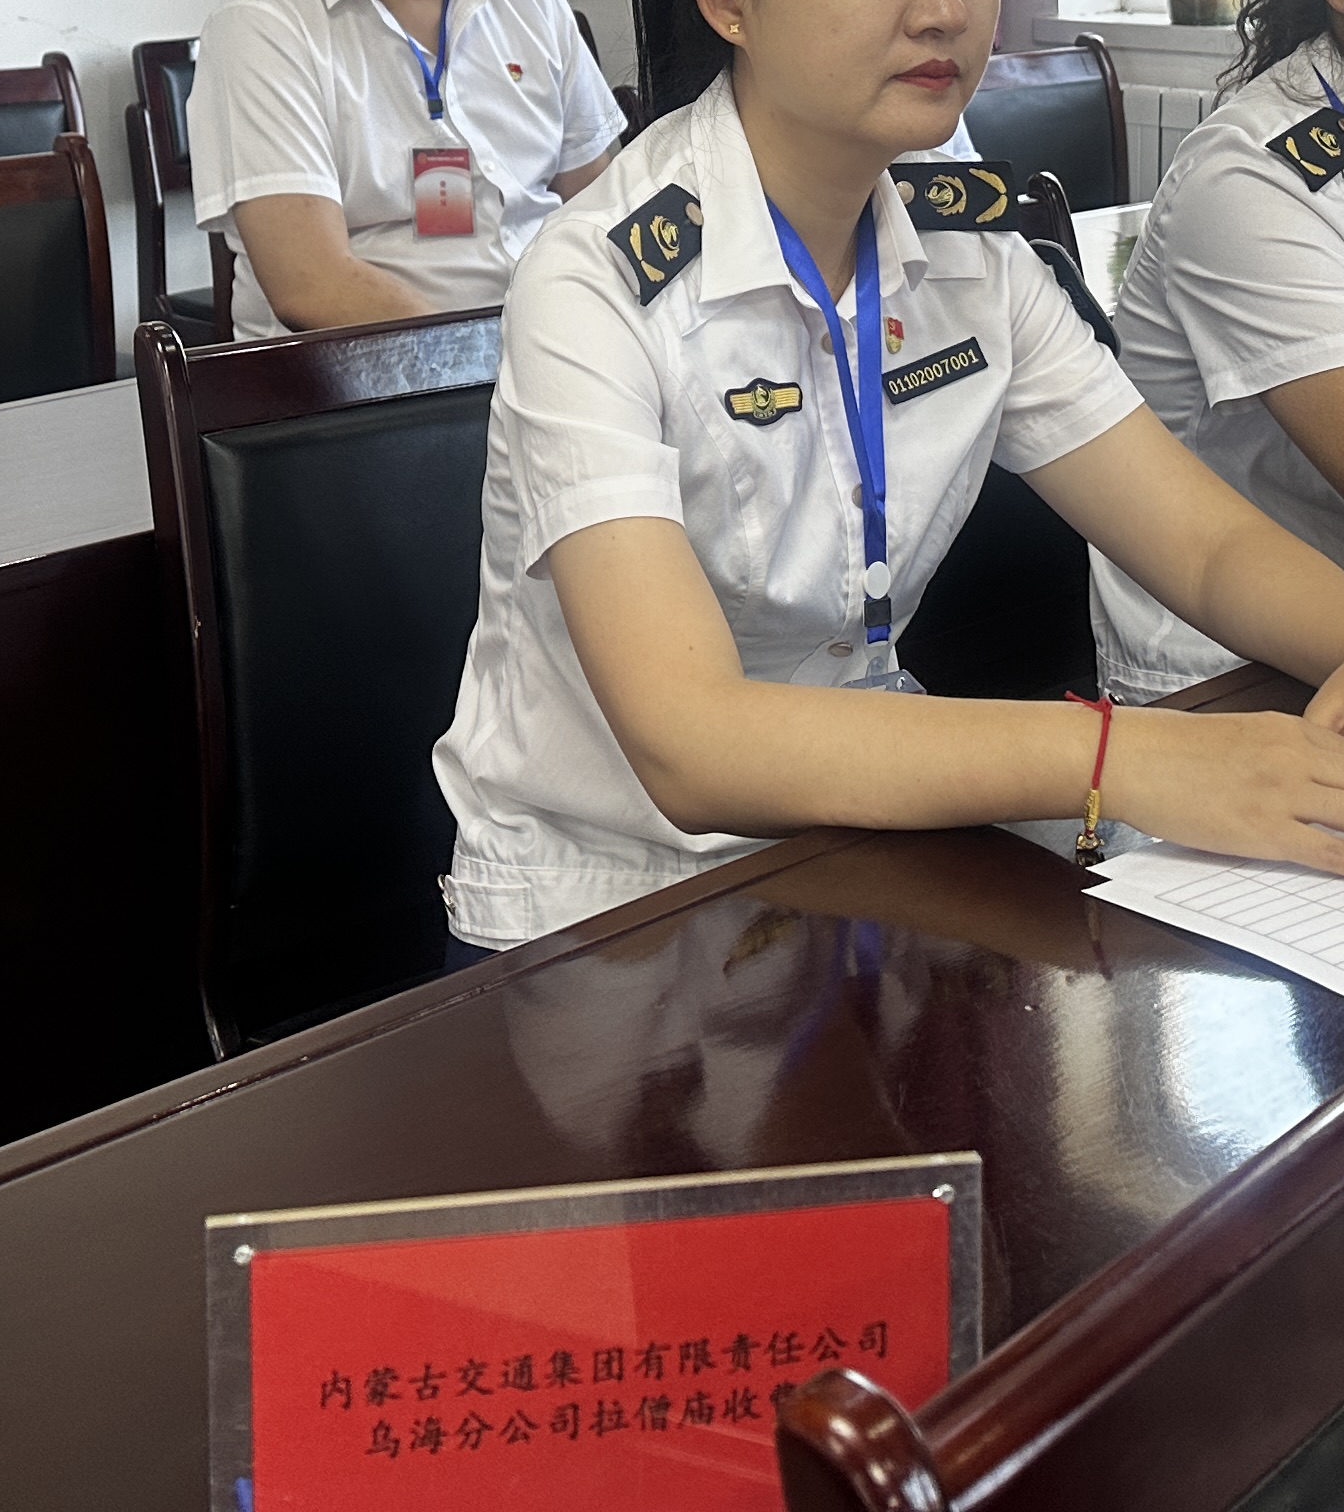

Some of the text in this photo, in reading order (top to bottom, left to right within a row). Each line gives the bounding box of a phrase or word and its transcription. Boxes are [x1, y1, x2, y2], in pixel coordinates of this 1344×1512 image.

[888, 348, 979, 395] 01102007001
[320, 1320, 888, 1411] 内蒙古交通集团有限责任公司
